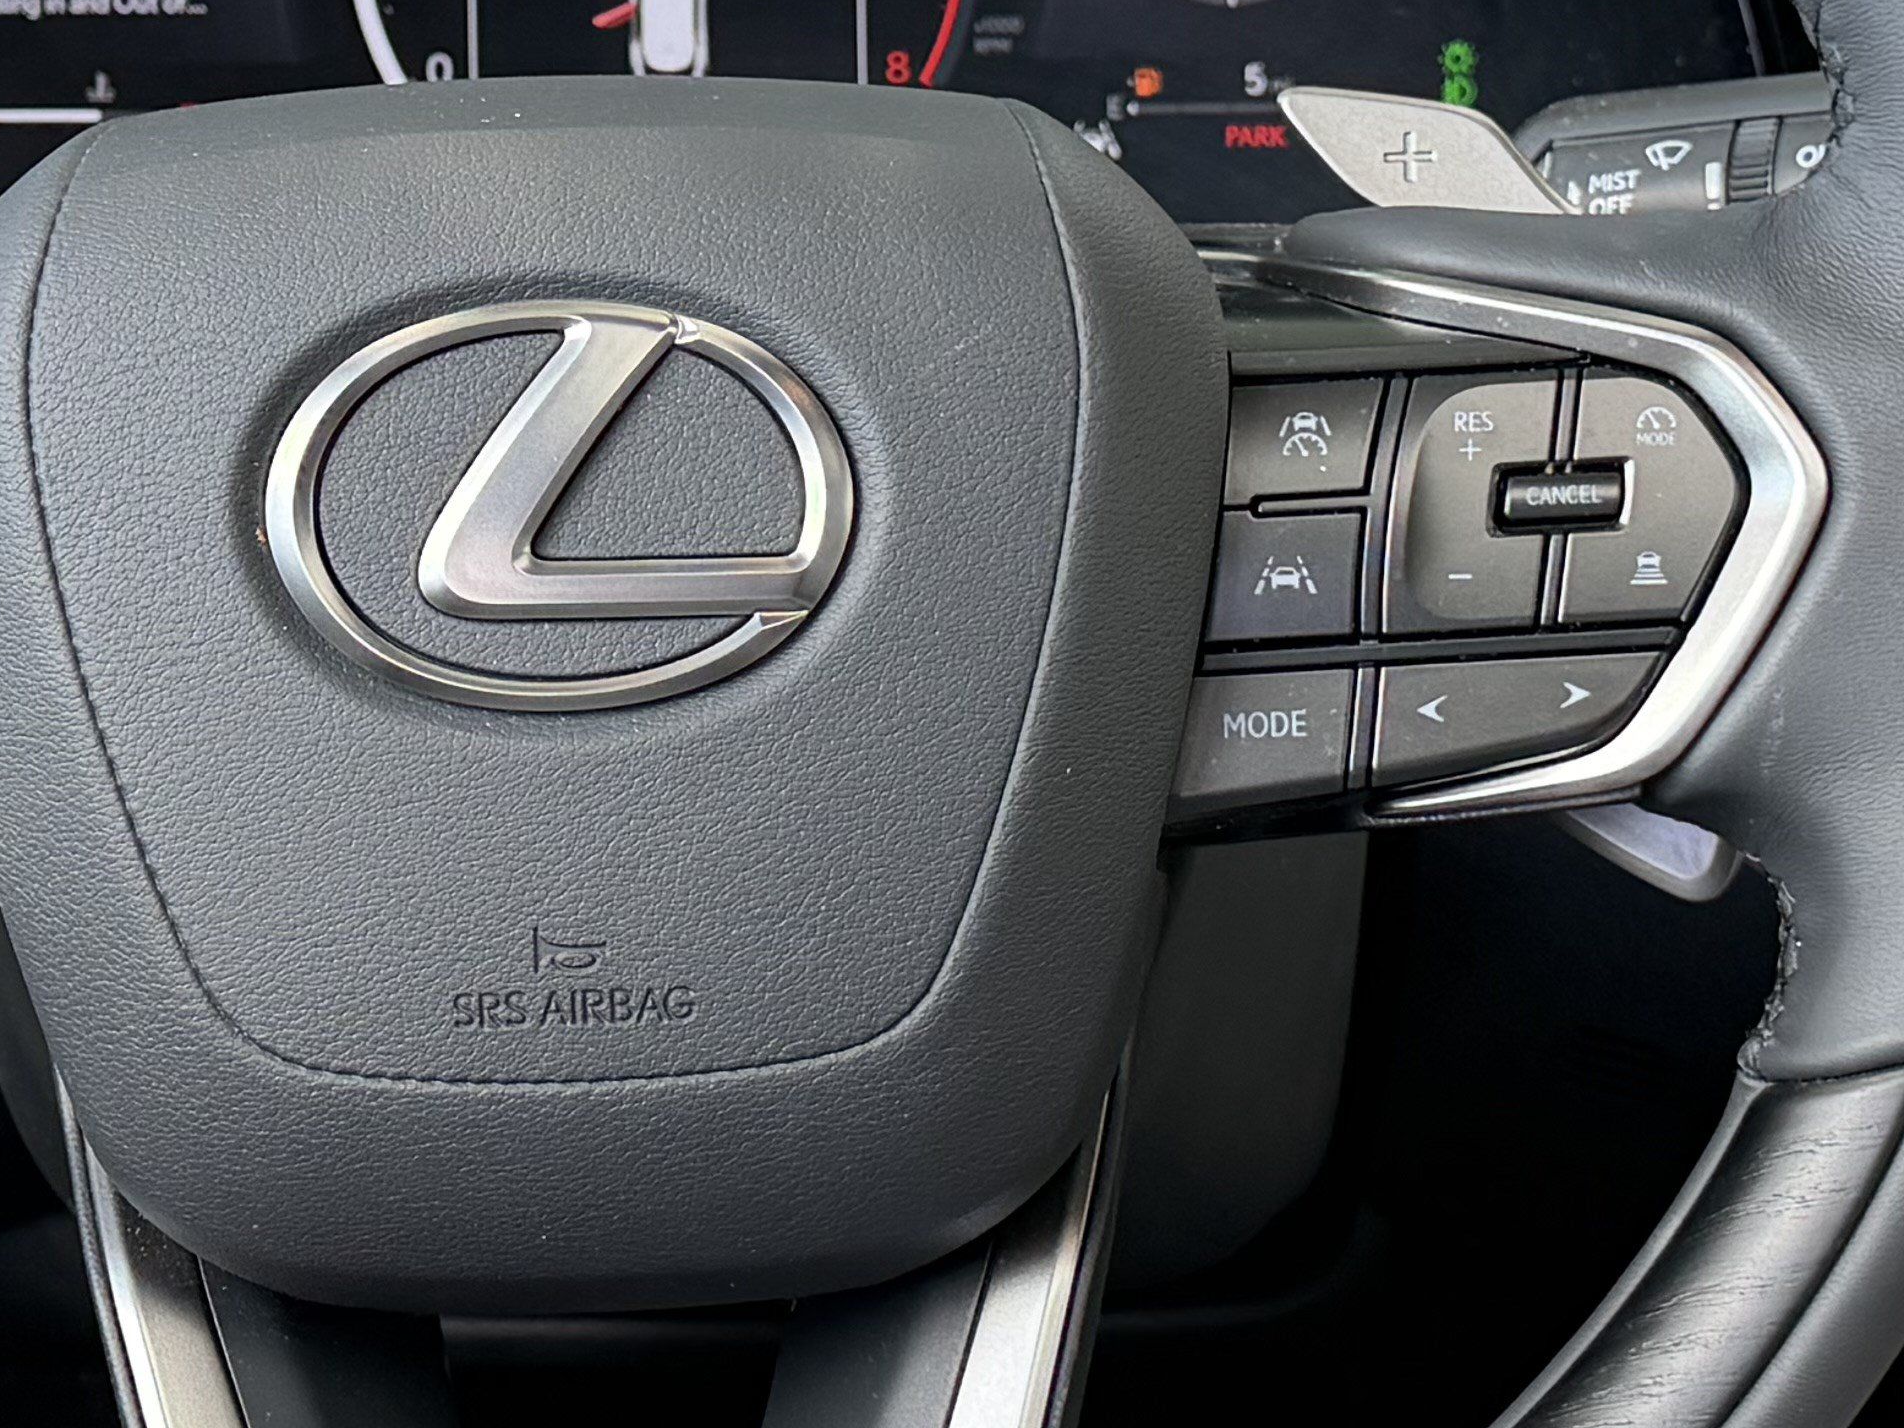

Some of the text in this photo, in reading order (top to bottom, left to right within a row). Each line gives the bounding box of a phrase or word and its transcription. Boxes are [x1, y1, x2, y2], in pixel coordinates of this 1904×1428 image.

[885, 50, 912, 85] 8
[1244, 61, 1268, 97] 5
[1225, 124, 1287, 149] PARK
[1588, 169, 1642, 194] MIST
[1453, 410, 1494, 433] RES
[1636, 432, 1677, 447] MODE
[1526, 482, 1602, 506] CANCEL
[1223, 710, 1308, 740] MODE
[452, 984, 696, 1028] SRS AIRBAG
